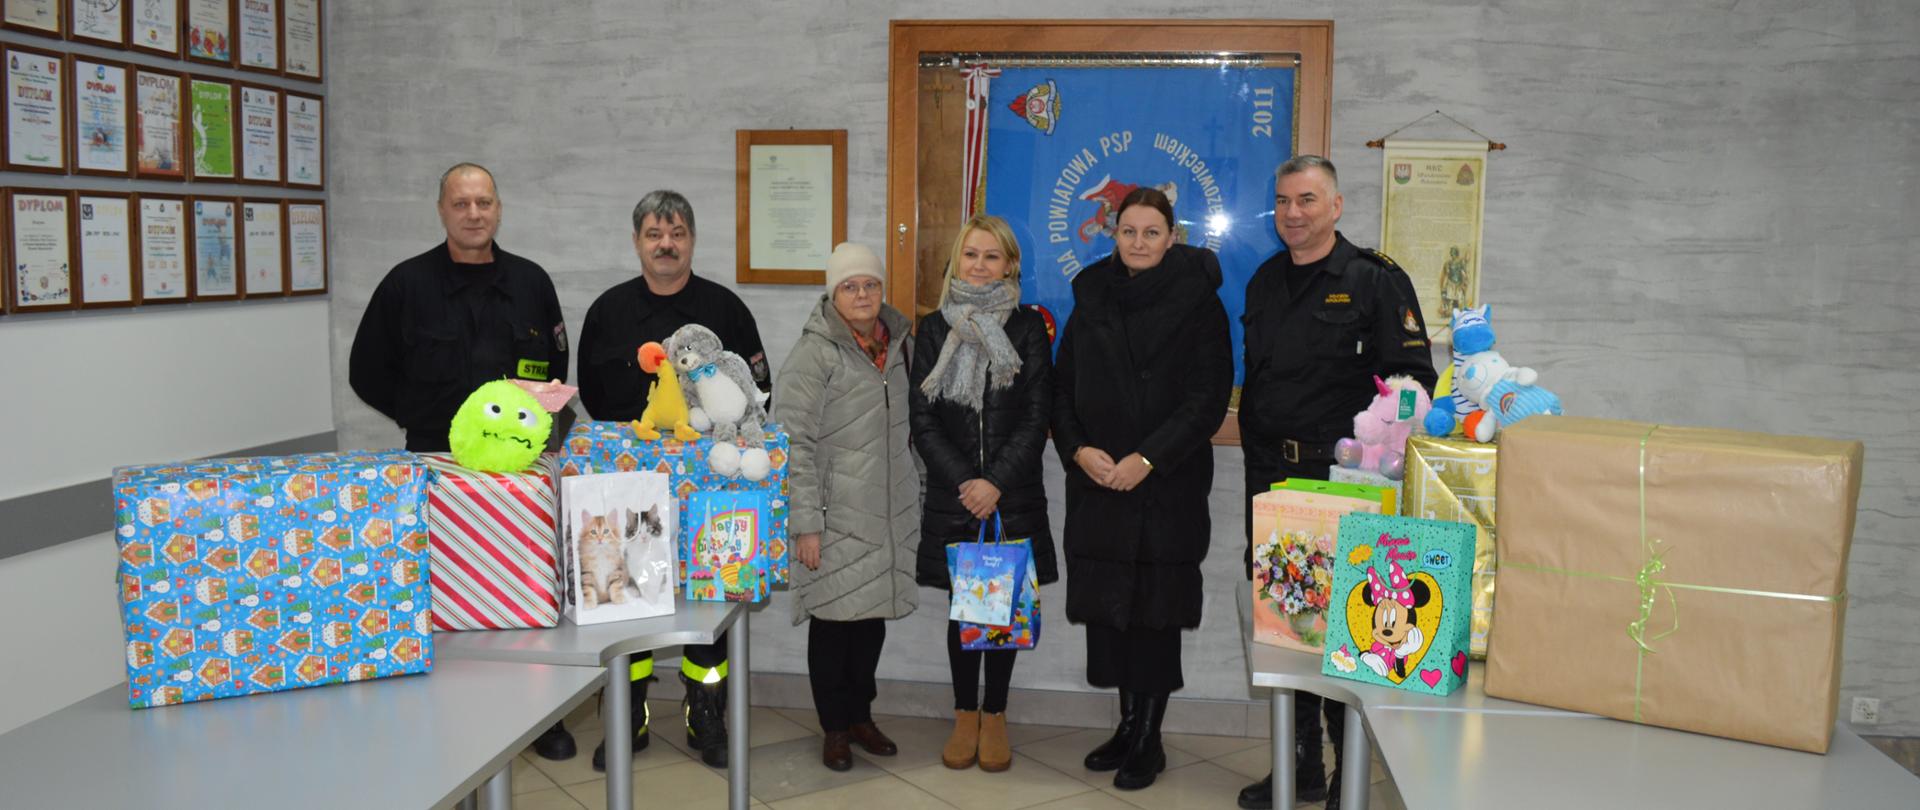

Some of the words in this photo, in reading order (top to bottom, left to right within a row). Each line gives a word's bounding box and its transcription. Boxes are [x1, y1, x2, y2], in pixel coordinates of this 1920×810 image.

[86, 81, 116, 94] DYPLOM
[139, 75, 176, 90] DYPLOM
[17, 85, 52, 102] DYPLOM
[1252, 87, 1274, 138] 2011
[1048, 147, 1098, 243] POWIATOWA
[1099, 130, 1133, 157] PSP
[18, 199, 64, 212] DYPLOM
[148, 225, 175, 235] DYPLOM
[1376, 532, 1411, 548] Minnie
[1385, 547, 1417, 562] Mouse
